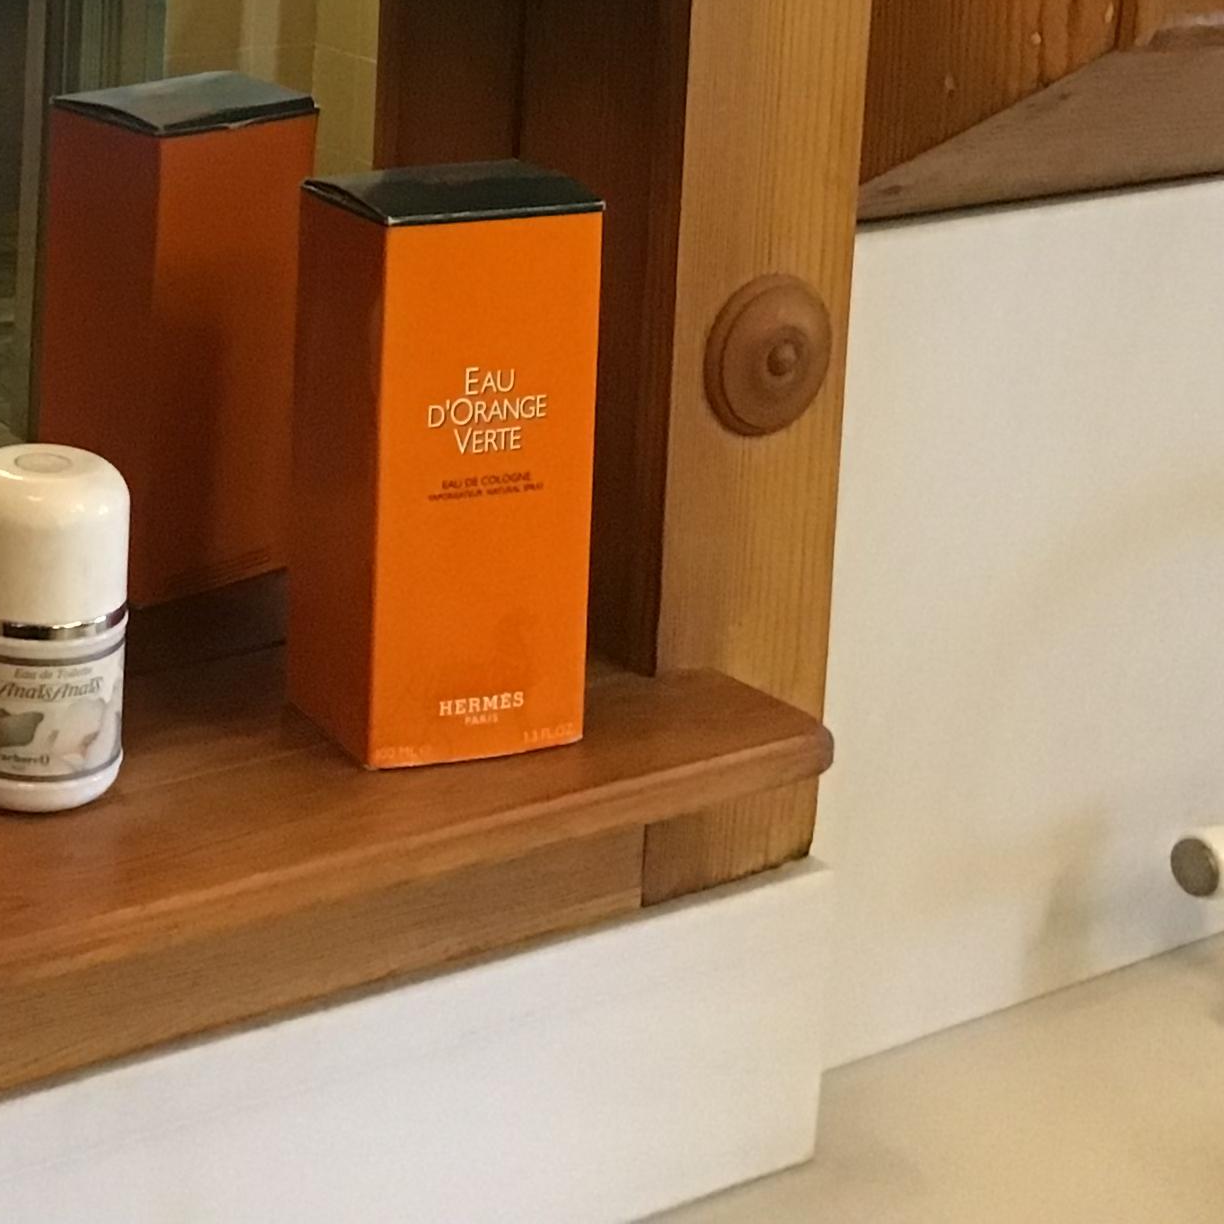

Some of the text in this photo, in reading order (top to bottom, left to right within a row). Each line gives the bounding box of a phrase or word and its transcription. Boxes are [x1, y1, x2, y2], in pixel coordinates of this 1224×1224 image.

[464, 366, 516, 395] EAU
[453, 426, 522, 454] VERTE
[441, 472, 531, 490] EAU DE COLOGNE
[465, 713, 499, 726] PARIS
